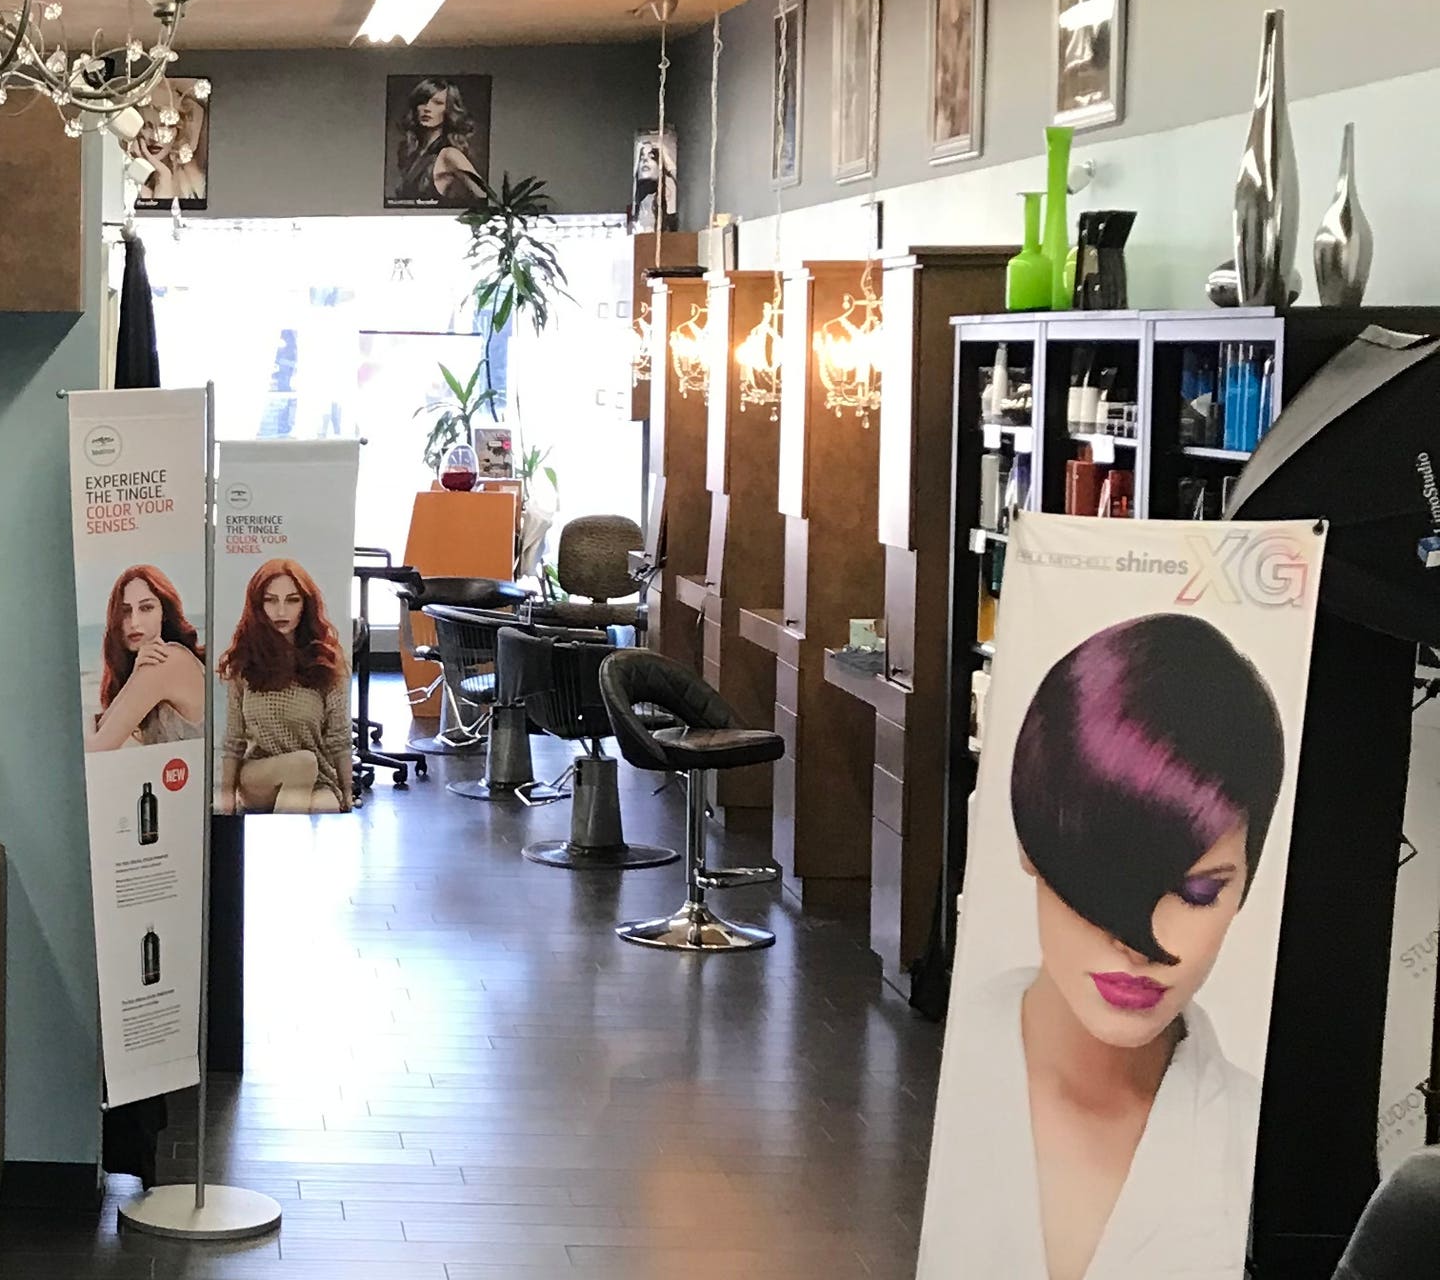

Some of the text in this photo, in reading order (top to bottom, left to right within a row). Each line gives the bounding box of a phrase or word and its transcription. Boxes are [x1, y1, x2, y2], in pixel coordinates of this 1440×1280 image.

[86, 469, 167, 490] EXPERIENCE
[86, 490, 112, 504] THE
[86, 499, 174, 519] COLOR YOUR
[226, 515, 283, 525] EXPERIENCE
[227, 525, 244, 534] THE
[226, 535, 288, 544] COLOR YOUR
[1115, 550, 1189, 575] shines
[1175, 529, 1309, 608] XG
[165, 768, 186, 783] NEW
